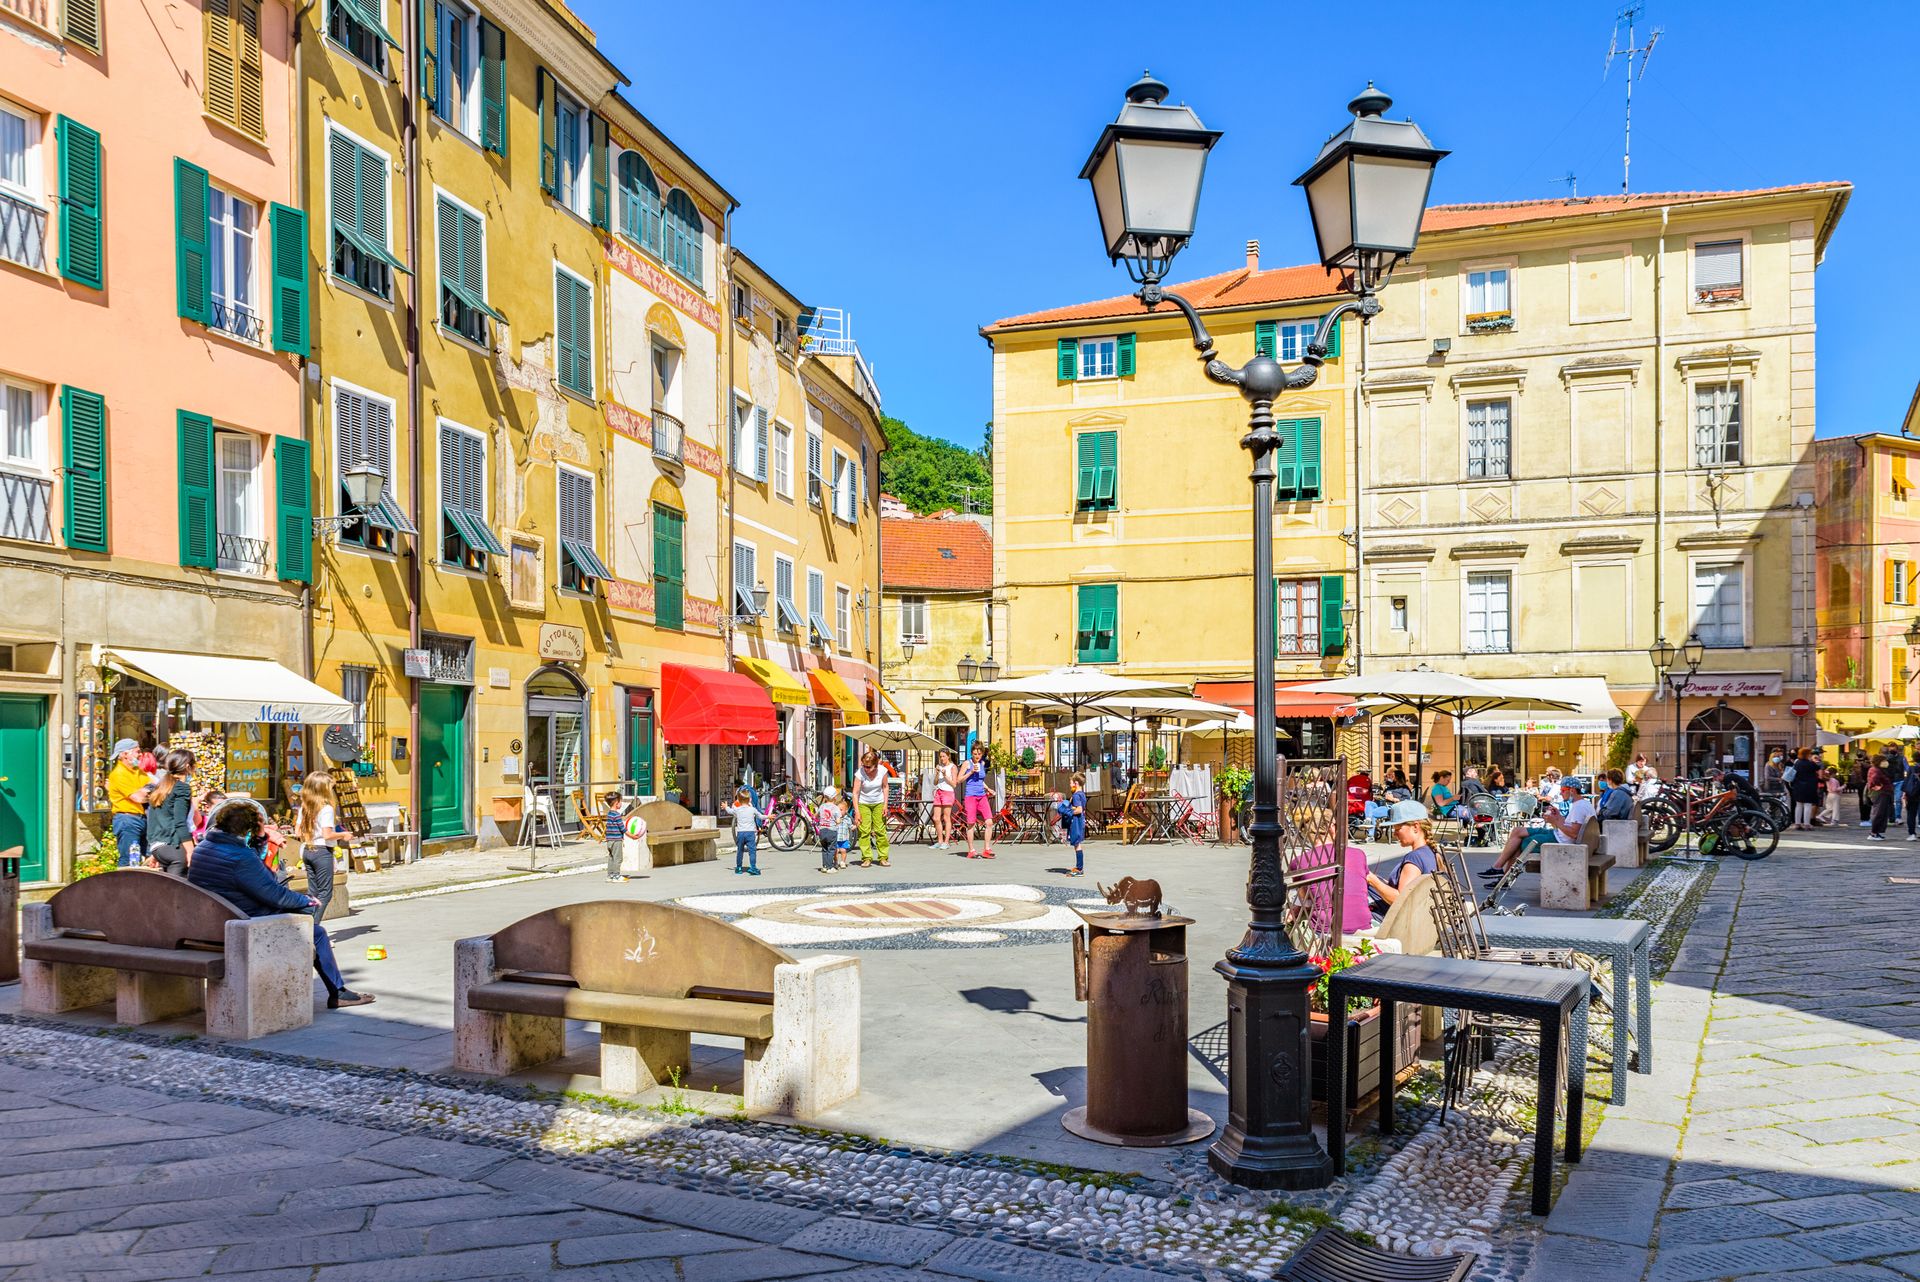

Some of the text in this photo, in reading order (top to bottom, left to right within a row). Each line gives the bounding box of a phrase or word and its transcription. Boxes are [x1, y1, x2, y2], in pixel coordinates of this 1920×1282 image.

[567, 631, 581, 656] SANTO
[1684, 682, 1719, 693] Domus
[1720, 682, 1733, 692] de
[255, 704, 300, 722] Manù
